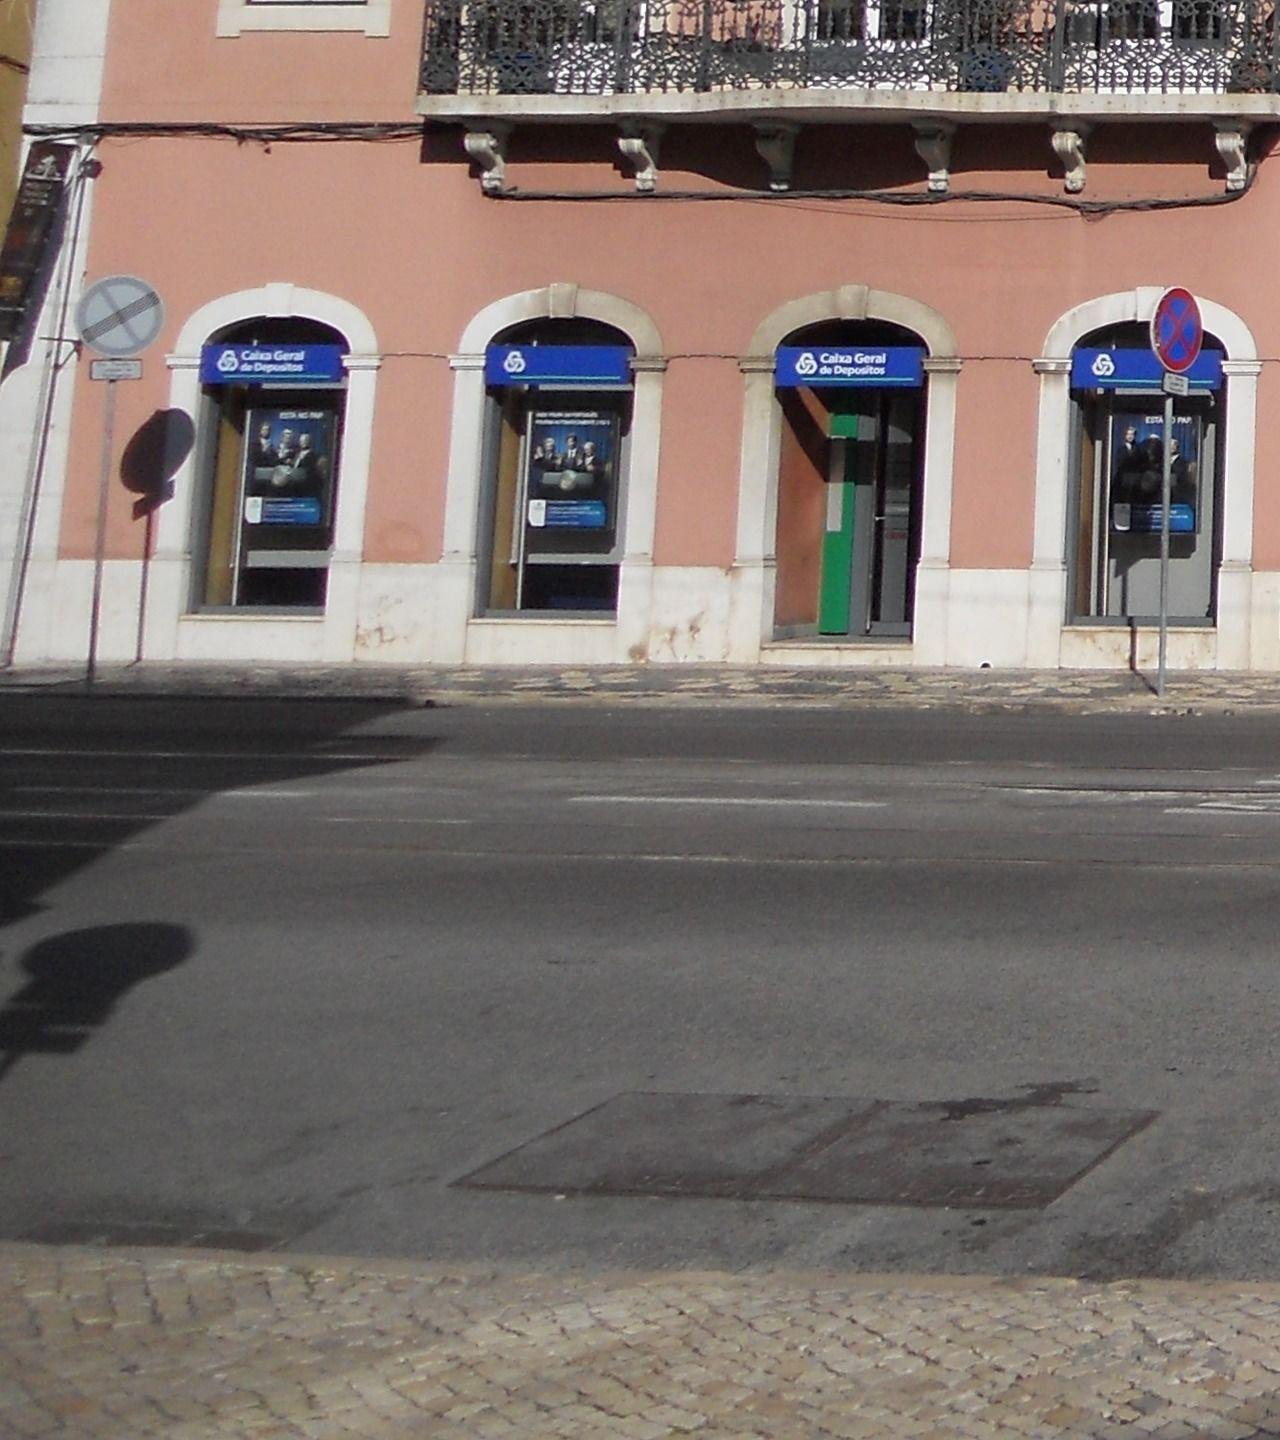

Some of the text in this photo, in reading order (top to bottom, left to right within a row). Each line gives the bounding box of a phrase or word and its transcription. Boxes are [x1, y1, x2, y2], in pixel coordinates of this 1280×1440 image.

[241, 350, 305, 361] Caixa Geral
[820, 352, 887, 364] Caixa Geral
[819, 365, 832, 375] de
